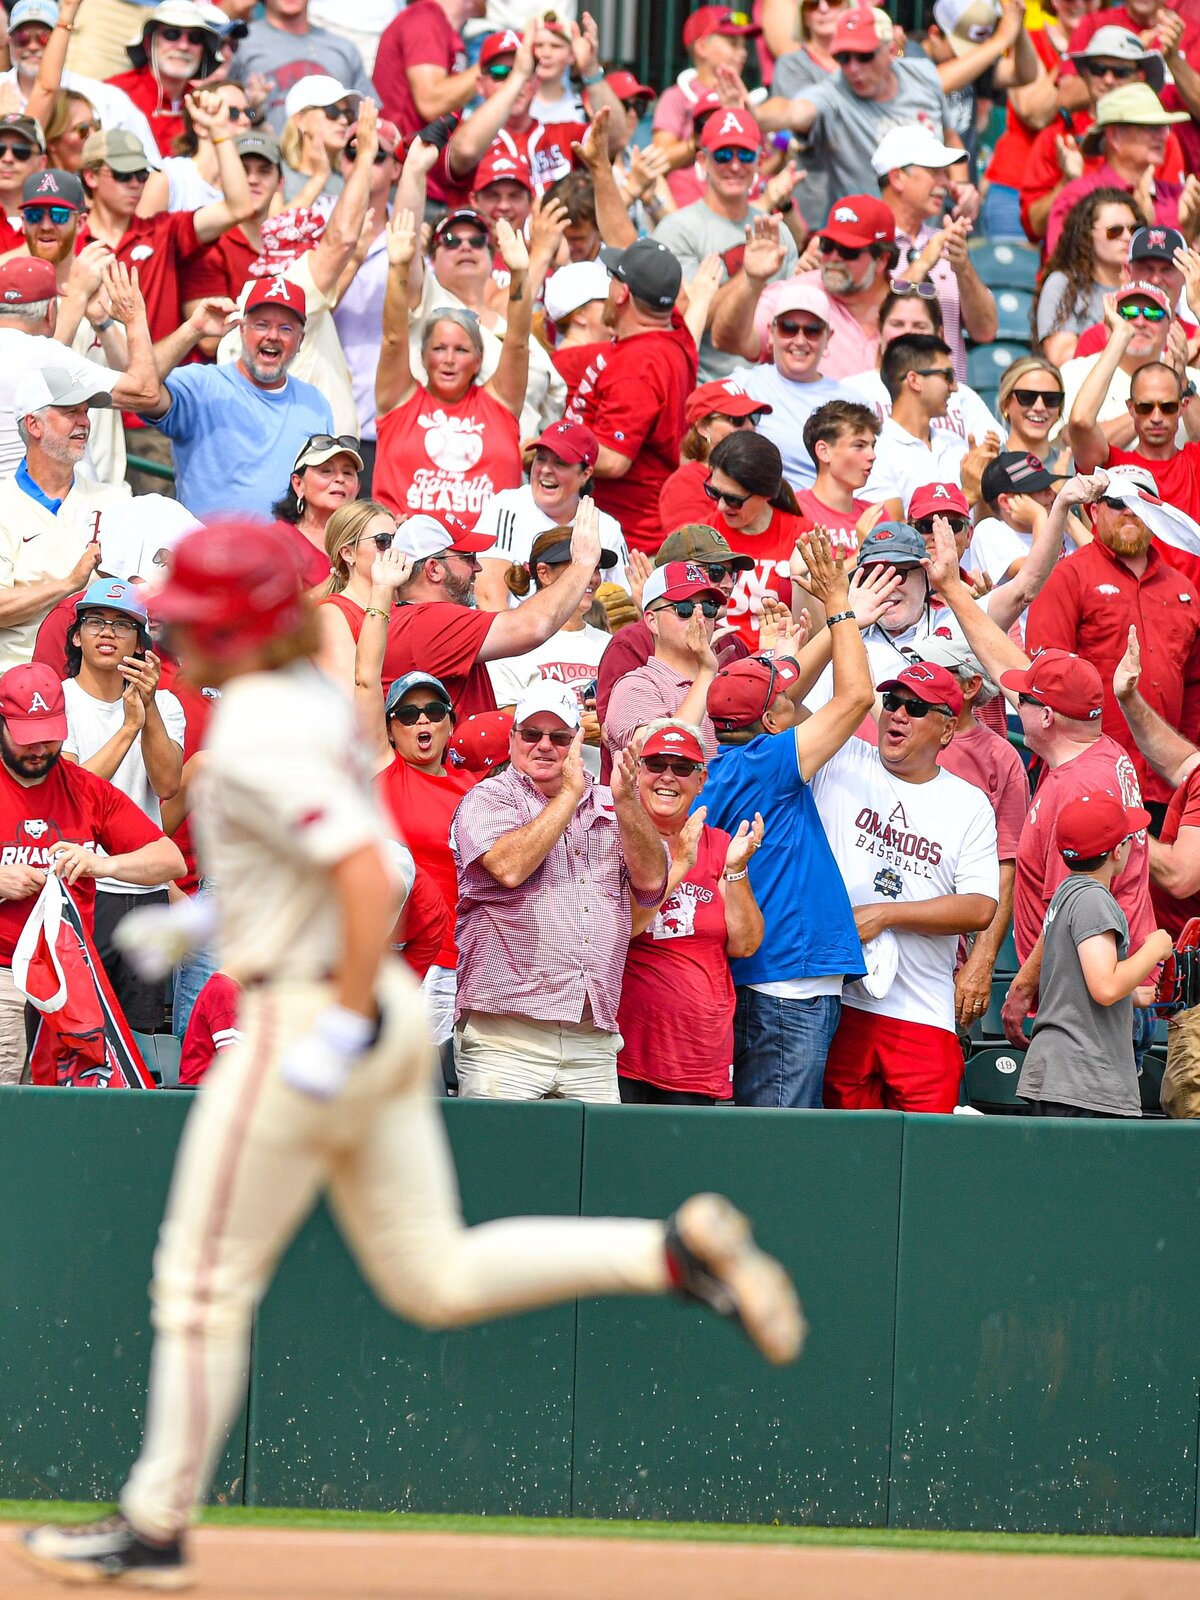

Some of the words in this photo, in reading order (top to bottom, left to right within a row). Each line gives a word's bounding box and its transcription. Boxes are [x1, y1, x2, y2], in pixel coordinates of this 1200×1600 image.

[719, 112, 744, 134] A
[36, 173, 59, 192] A
[265, 276, 290, 301] A
[932, 484, 951, 500] A
[105, 584, 126, 599] S
[28, 692, 51, 713] A
[888, 801, 910, 828] A
[855, 807, 942, 866] OMAHOGS
[855, 833, 932, 880] BASEBALL
[1000, 1060, 1012, 1070] 19
